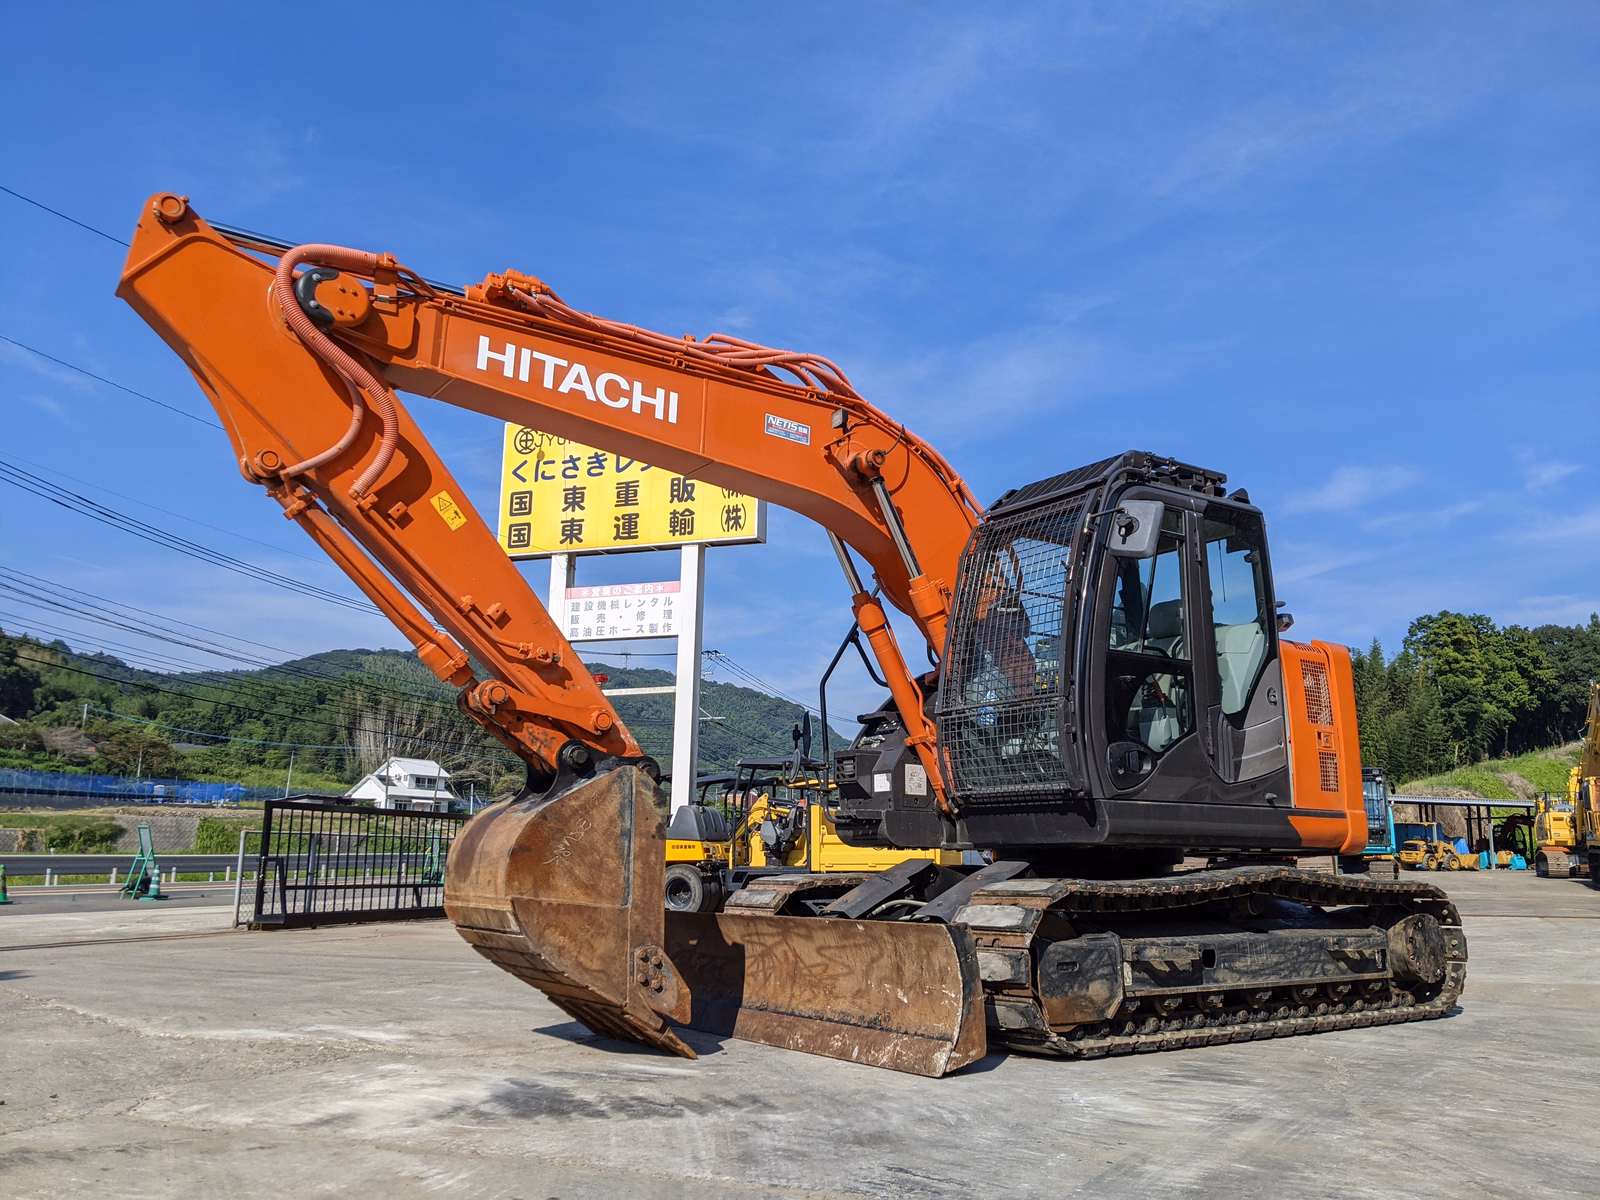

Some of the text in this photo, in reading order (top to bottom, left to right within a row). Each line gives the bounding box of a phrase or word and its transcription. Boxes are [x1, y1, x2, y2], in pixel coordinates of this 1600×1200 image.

[476, 335, 679, 424] HITACHI
[767, 416, 798, 431] NETIS
[571, 597, 673, 612] 建設機械レンタル
[569, 622, 672, 638] 高油圧ホース製作
